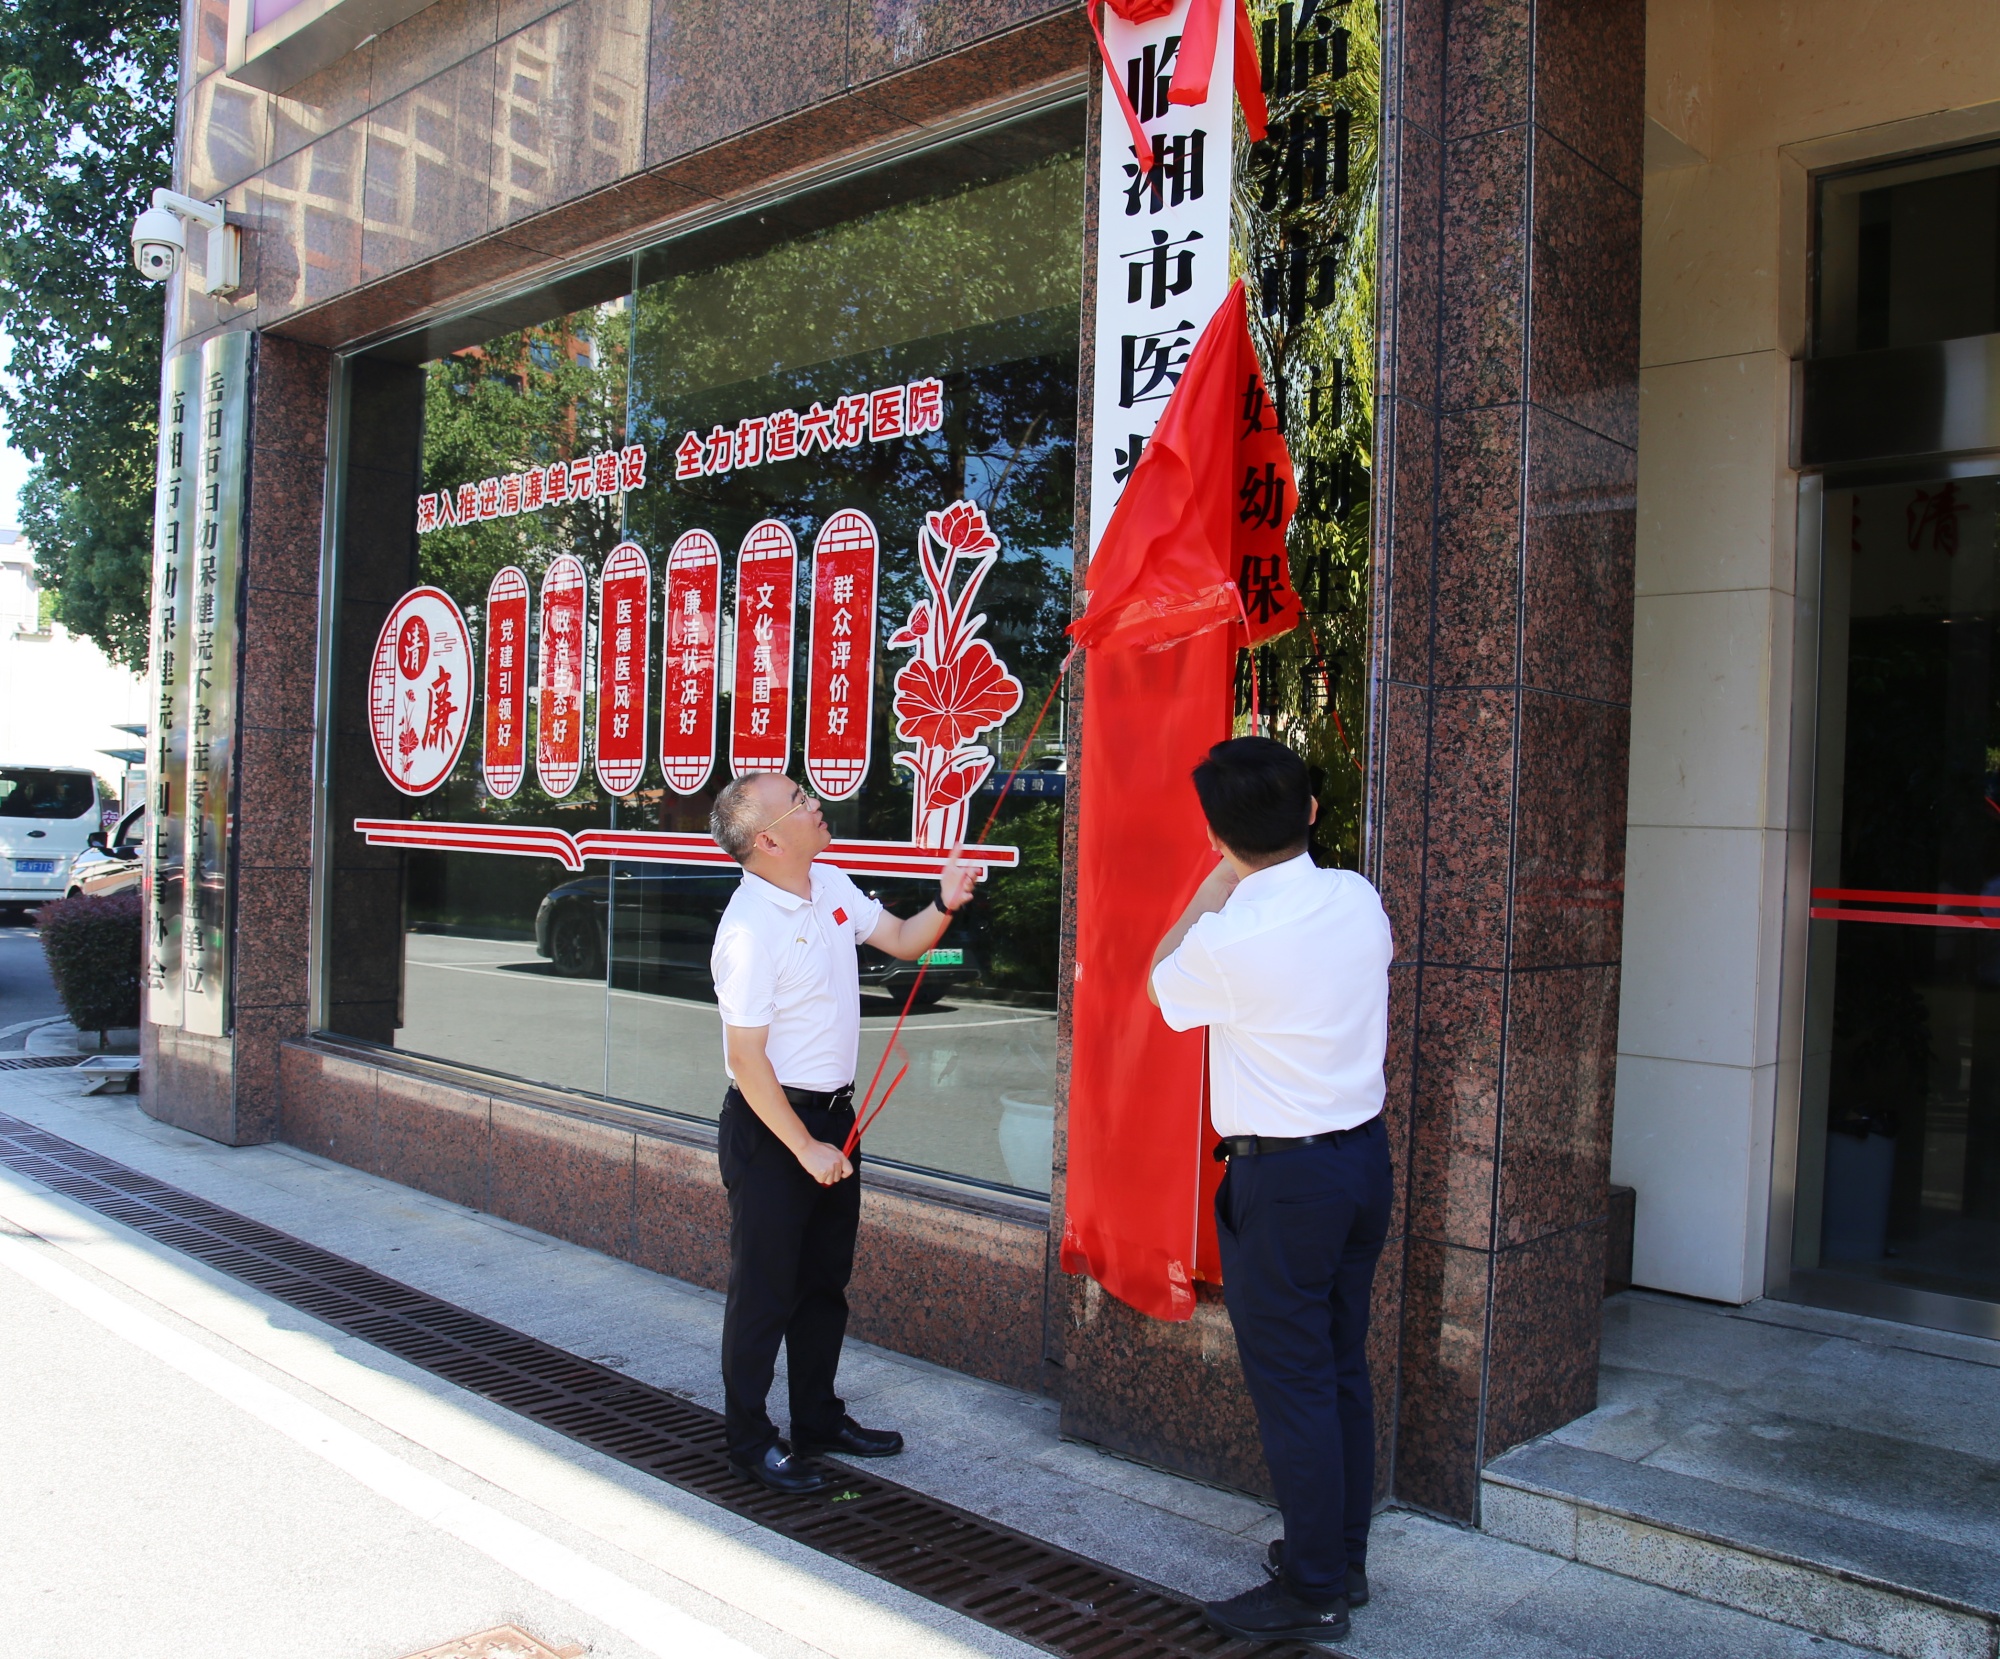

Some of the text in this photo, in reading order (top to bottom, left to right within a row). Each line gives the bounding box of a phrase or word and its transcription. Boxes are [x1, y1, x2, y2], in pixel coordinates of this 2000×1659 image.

[416, 446, 647, 533] 深入推进清廉单元建设
[675, 377, 944, 480] 全力打造六好医院
[1233, 373, 1287, 717] 妇幼保健
[1296, 358, 1356, 715] 计划生育
[497, 618, 514, 747] 党建引领好
[552, 610, 571, 744] 政治生态好
[613, 598, 633, 739] 医德医风好
[679, 589, 702, 736] 廉洁状况好
[751, 582, 775, 736] 文化氛围好
[827, 574, 854, 737] 群众评价好
